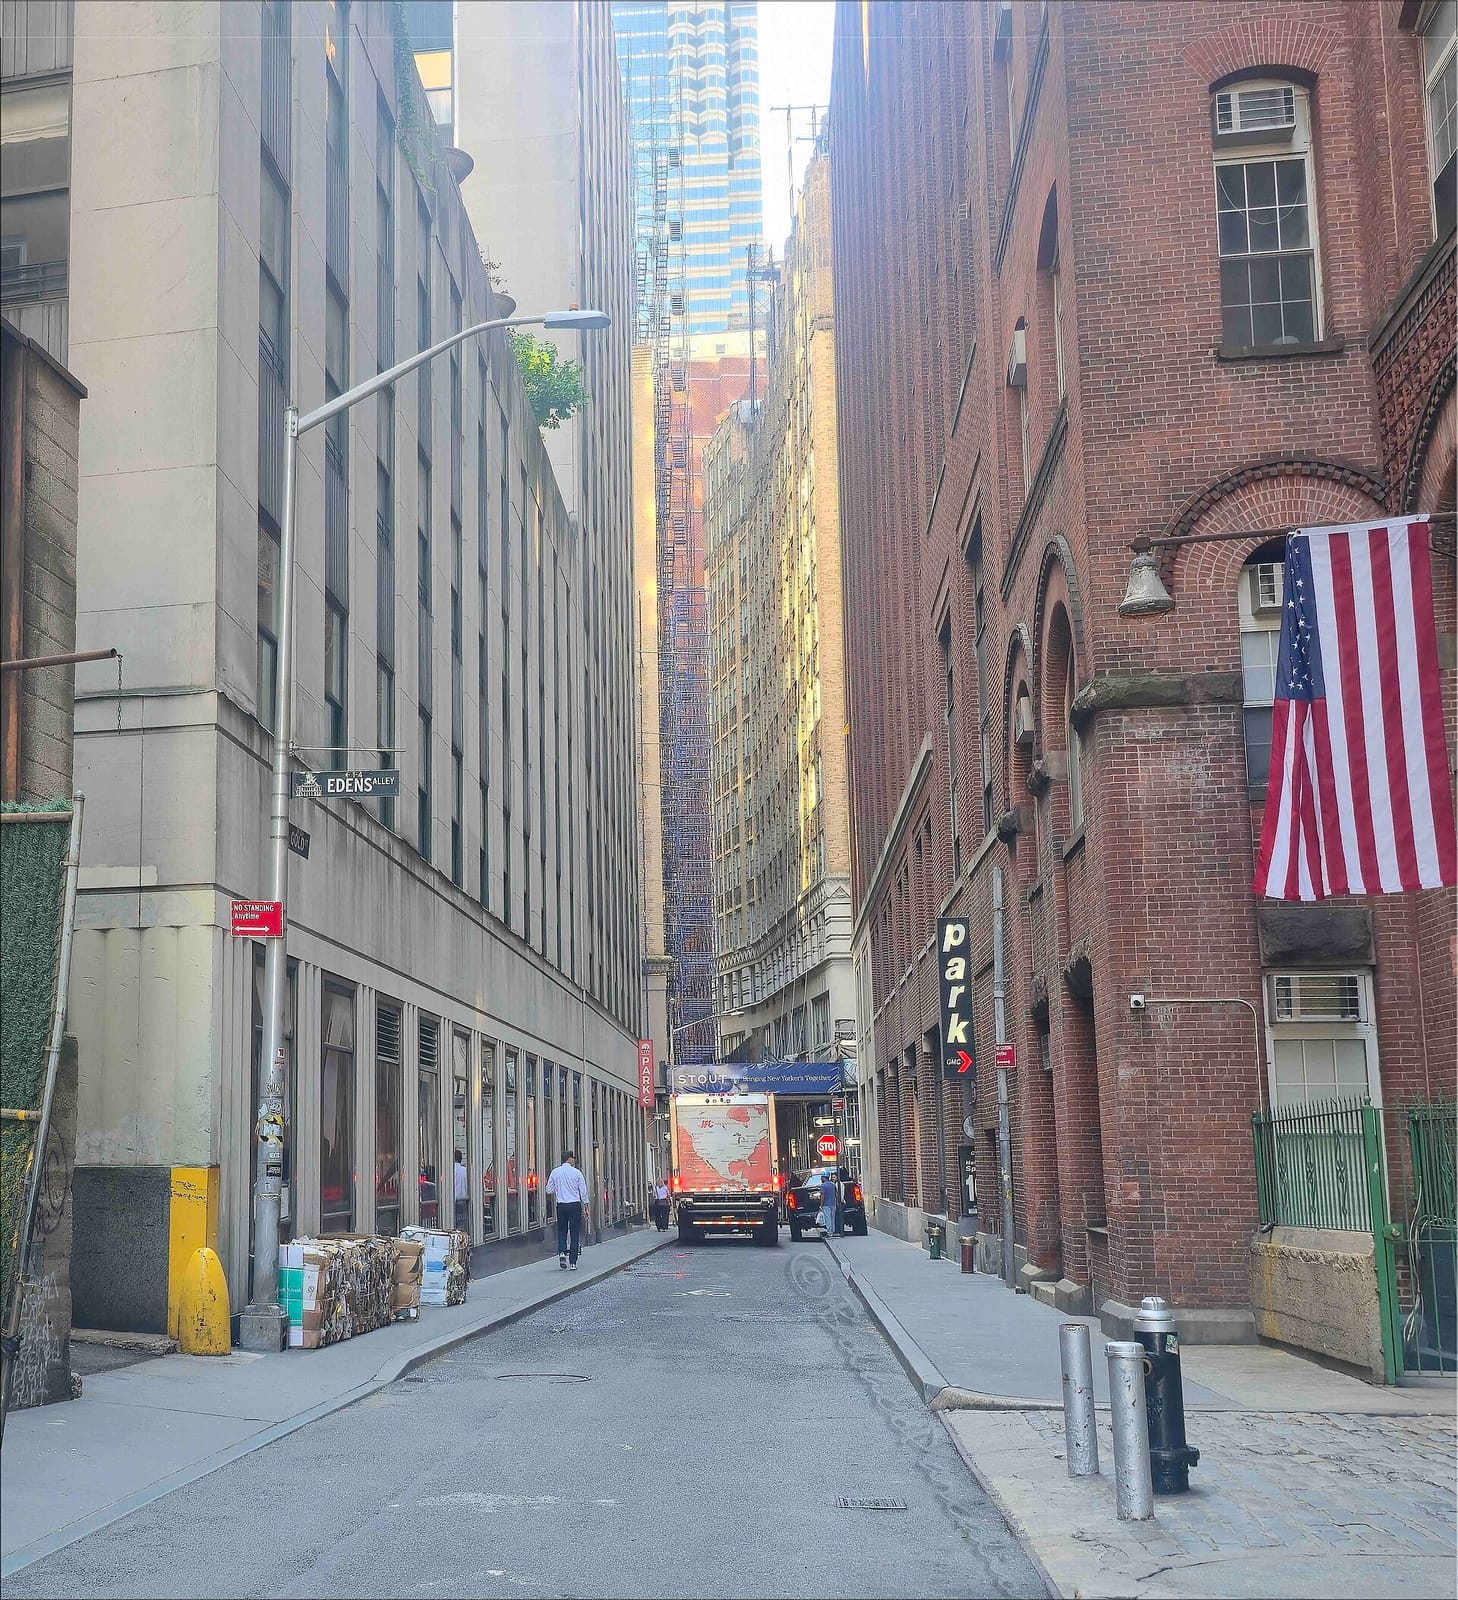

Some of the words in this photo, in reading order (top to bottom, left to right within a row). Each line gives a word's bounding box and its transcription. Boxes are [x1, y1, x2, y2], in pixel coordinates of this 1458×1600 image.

[327, 777, 373, 793] EDENS
[372, 776, 395, 785] ALLEY
[244, 904, 274, 912] STANDING
[234, 912, 260, 920] Anytime
[942, 923, 970, 1044] park
[946, 1058, 962, 1066] GMC
[642, 1056, 651, 1094] PARK
[678, 1074, 727, 1084] STOUT
[742, 1075, 767, 1083] Bringing
[804, 1075, 832, 1083] Together
